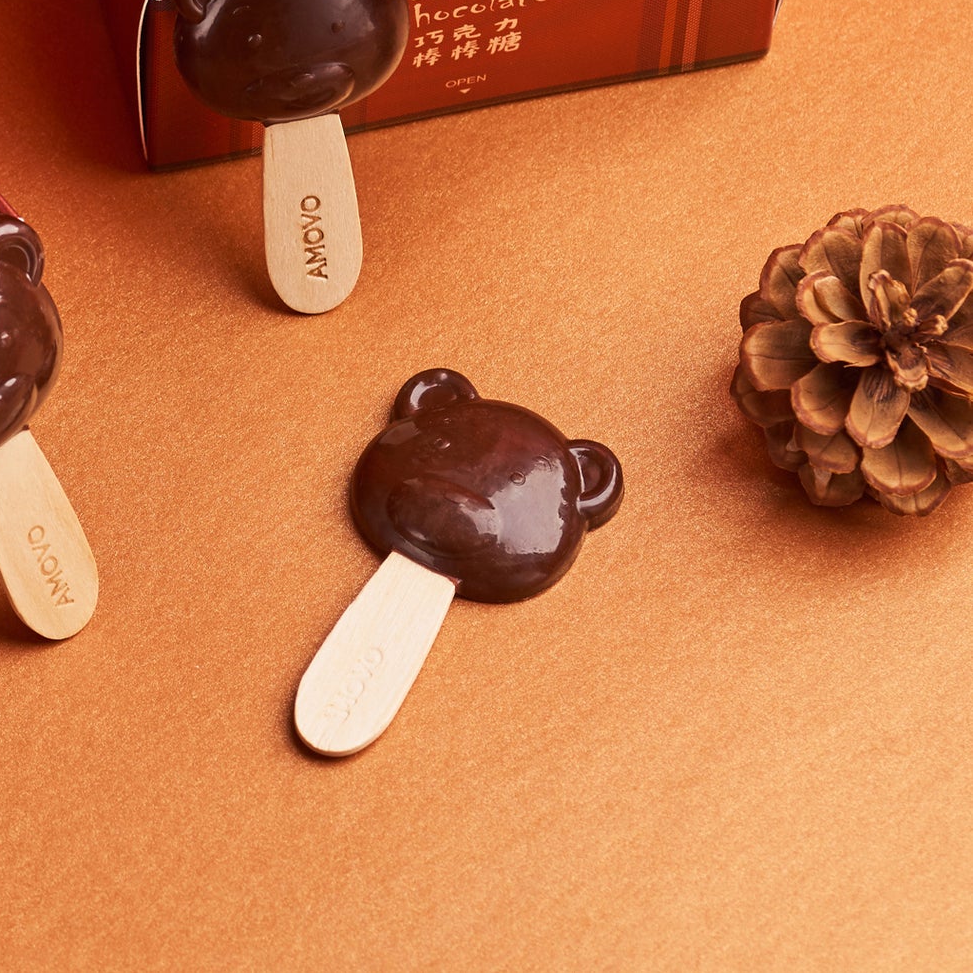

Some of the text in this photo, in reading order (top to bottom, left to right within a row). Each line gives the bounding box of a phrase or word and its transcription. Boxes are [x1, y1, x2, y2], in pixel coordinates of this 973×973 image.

[412, 31, 522, 68] 棒棒糖
[414, 17, 519, 48] 巧克力
[445, 74, 487, 88] OPEN
[300, 195, 329, 279] AMOVO
[27, 525, 75, 607] AMOVO
